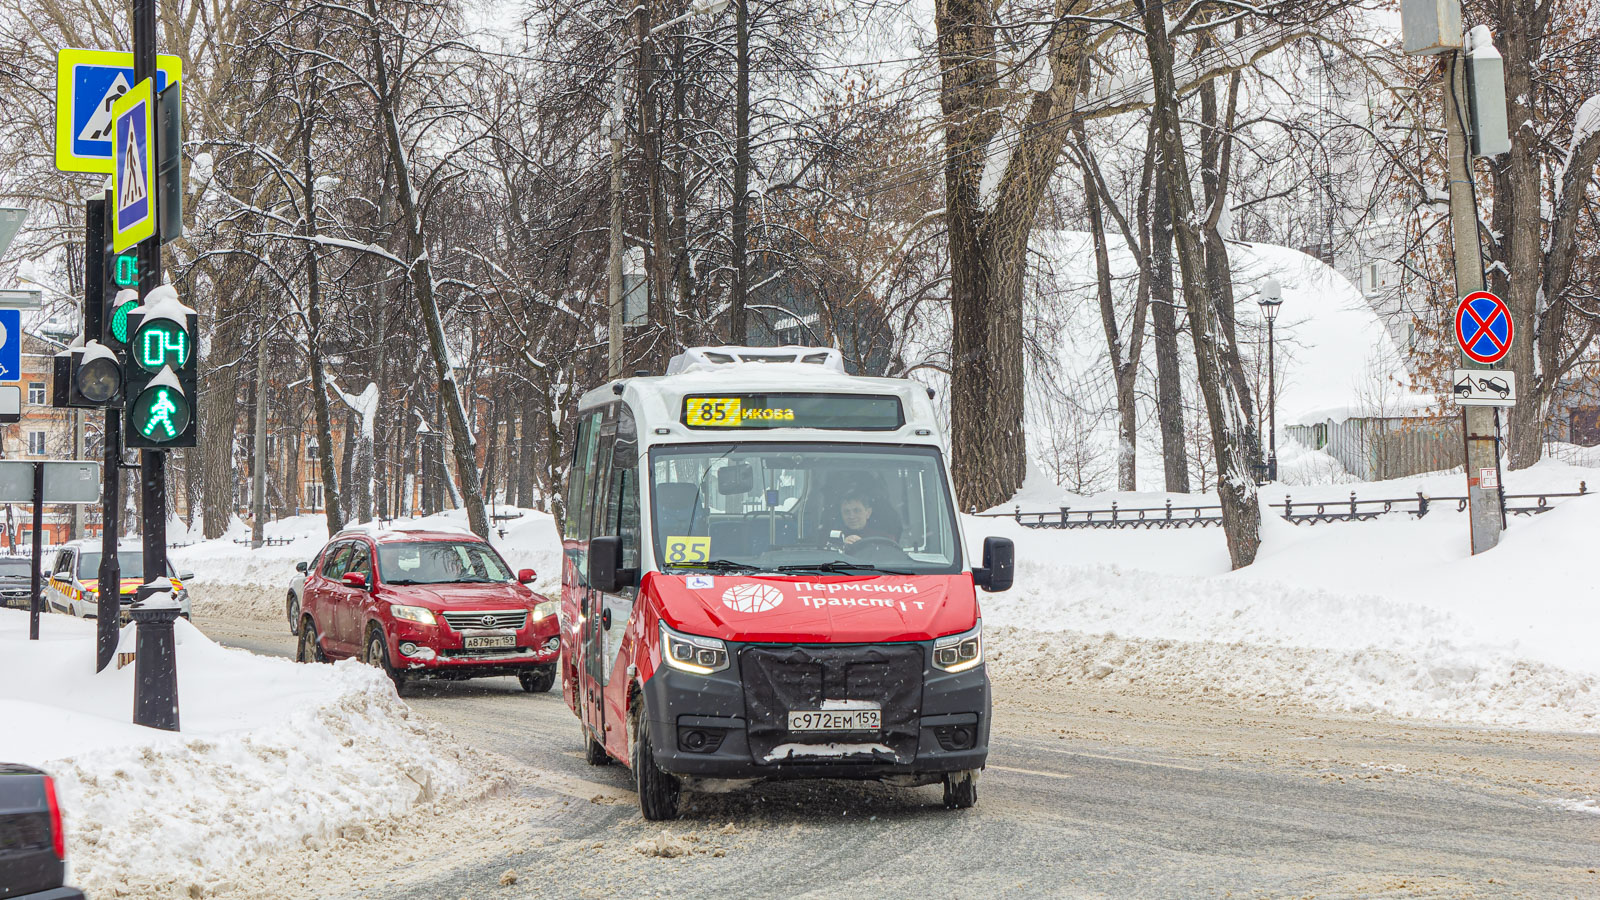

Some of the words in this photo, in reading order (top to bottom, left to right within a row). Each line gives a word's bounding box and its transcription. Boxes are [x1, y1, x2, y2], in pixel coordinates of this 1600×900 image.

[144, 329, 184, 366] 04
[701, 402, 726, 422] 85
[669, 542, 706, 563] 85
[794, 581, 918, 594] Пермский
[793, 713, 853, 729] С972ЕМ
[855, 712, 878, 724] 159
